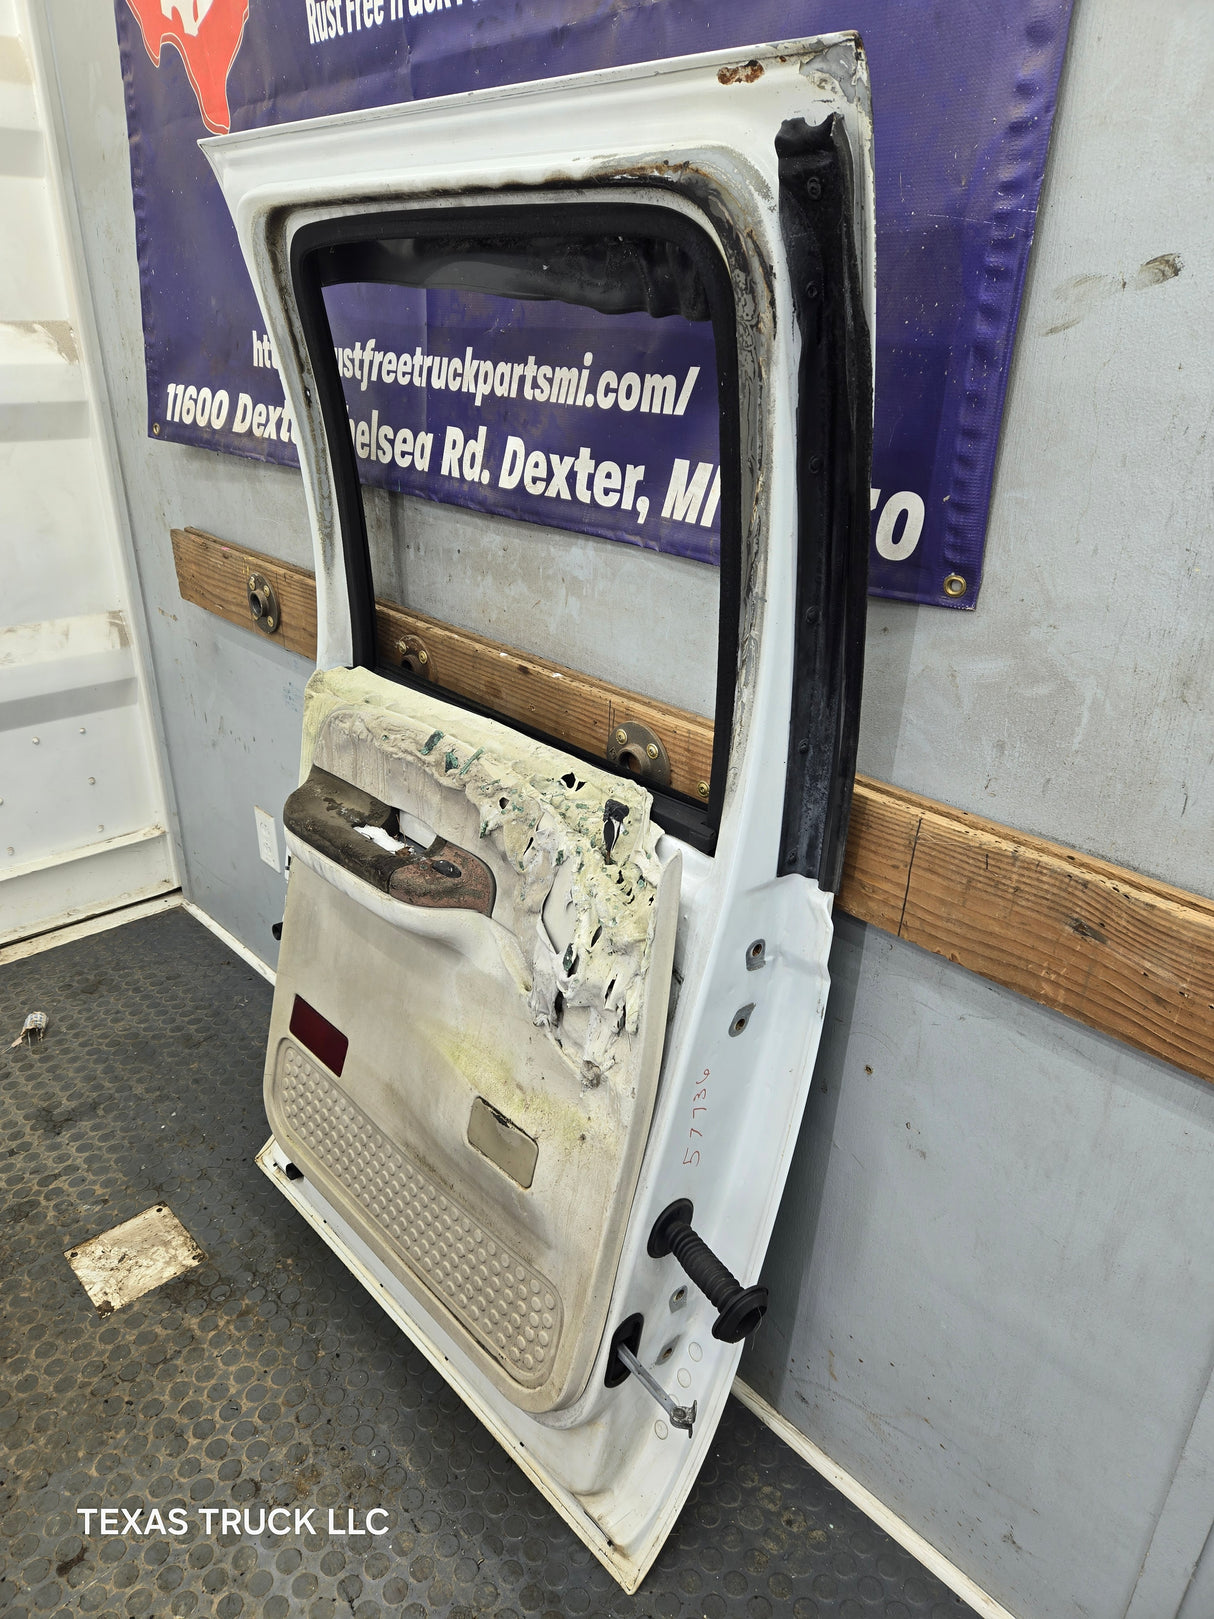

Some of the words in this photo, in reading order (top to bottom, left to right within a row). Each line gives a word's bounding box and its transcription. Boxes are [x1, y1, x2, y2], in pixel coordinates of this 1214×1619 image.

[306, 0, 344, 44] Rust
[345, 0, 384, 34] Free
[166, 383, 228, 430] 11600
[232, 392, 299, 445] Dext
[440, 425, 490, 485] Rd.
[498, 435, 650, 524] Dexter,
[683, 1068, 710, 1167] 57736
